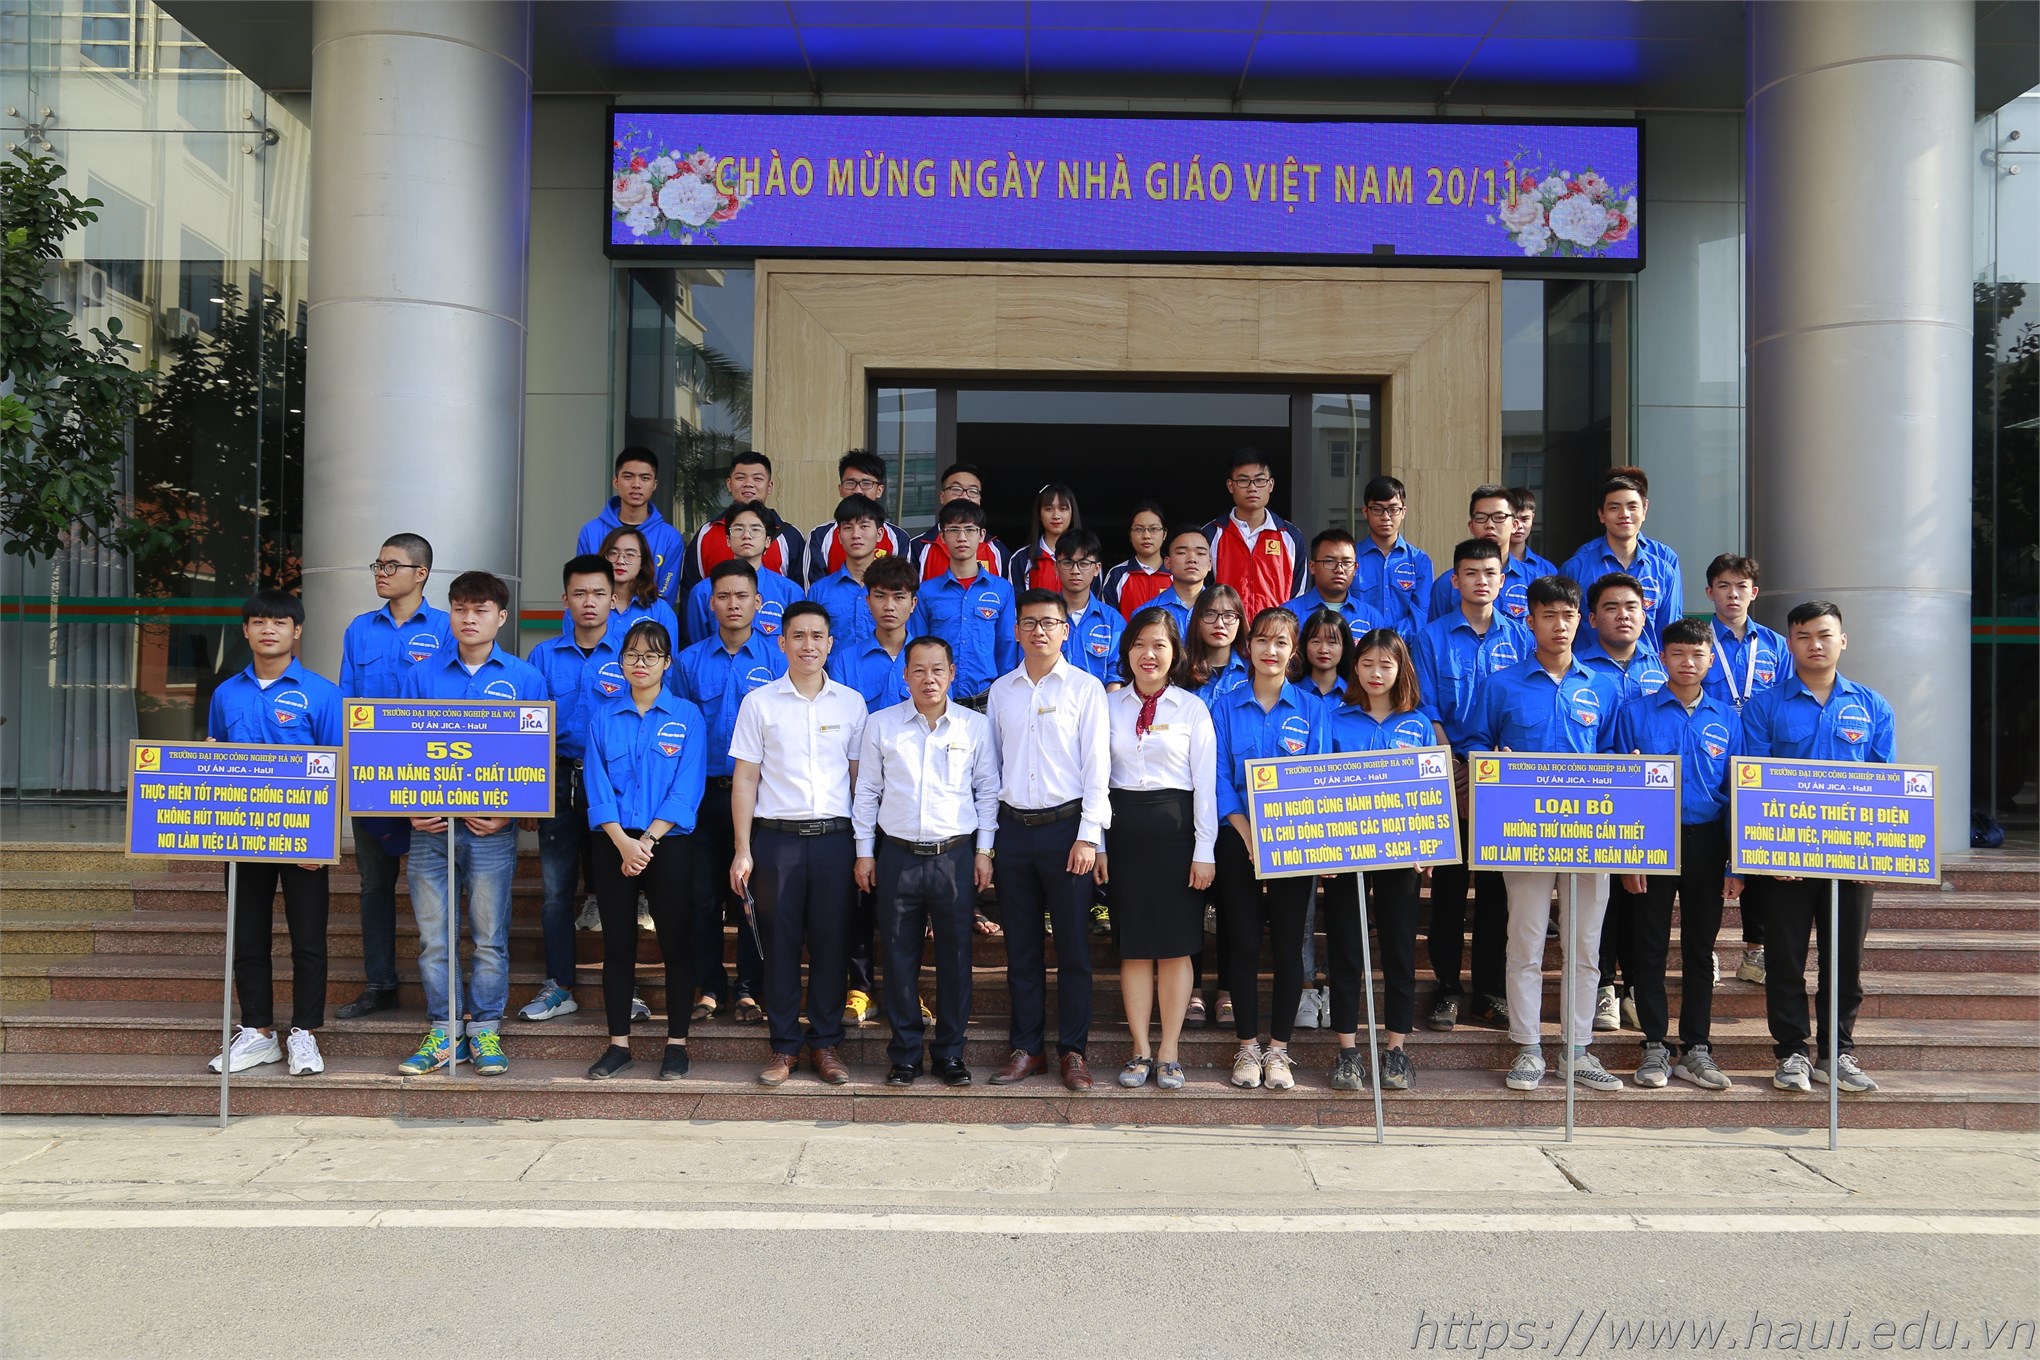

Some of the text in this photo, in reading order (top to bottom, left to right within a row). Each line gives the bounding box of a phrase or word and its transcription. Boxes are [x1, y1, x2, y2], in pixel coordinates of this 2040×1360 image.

[715, 149, 1518, 213] CHÀO MỪNG NGÀY NHÀ GIÁO VIỆT NAM 20/11
[382, 708, 410, 716] TRƯỜNG
[427, 709, 442, 718] HỌC
[443, 709, 462, 717] CÔNG
[464, 710, 490, 719] NGHIỆP
[492, 710, 501, 718] HÀ
[503, 710, 515, 719] NỘI
[412, 722, 424, 730] DỰ
[426, 721, 439, 729] ÁN
[169, 750, 303, 764] TRƯỜNG ĐẠI HỌC CÔNG NGHIỆP HÀ NỘI
[427, 742, 472, 759] 5S
[198, 765, 209, 774] DỰ
[212, 764, 225, 773] ÁN
[352, 762, 545, 785] TẠO RA NĂNG SUẤT CHẤT LƯỢNG
[1285, 757, 1415, 775] TRƯỜNG ĐẠI HỌC CÔNG NGHIỆP NỘI
[1508, 762, 1536, 771] TRƯỜNG
[1552, 764, 1567, 772] HỌC
[1567, 763, 1586, 771] CÔNG
[1589, 764, 1615, 773] NGHIỆP
[1617, 764, 1626, 772] HÀ
[1628, 764, 1641, 773] NỘI
[1770, 767, 1900, 781] TRƯỜNG ĐẠI HỌC CÔNG NGHIỆP NỘI
[1314, 777, 1326, 786] DỰ
[1328, 775, 1340, 783] ÁN
[1368, 773, 1388, 781] HaUI
[1537, 776, 1549, 785] DỰ
[1551, 775, 1564, 783] ÁN
[1798, 782, 1810, 791] DỰ
[1812, 781, 1824, 790] ÁN
[141, 782, 329, 804] THỰC HIỆN TỐT PHÒNG CHỐNG CHÁY NỔ
[390, 785, 508, 808] HIỆU QUẢ CÔNG VIỆC
[1264, 788, 1442, 820] MỌI NGƯỜI CÙNG HÀNH ĐỘNG, TỰ GIÁC
[1535, 794, 1613, 817] LOẠI BỎ
[1762, 798, 1909, 826] TẮT CÁC THIẾT BỊ ĐIỆN
[157, 807, 309, 829] KHÔNG HÚT THUỐC TẠI CƠ QUAN
[1260, 813, 1450, 842] VÀ CHỦ ĐỘNG TRONG CÁC HOẠT ĐỘNG 5S
[1504, 819, 1644, 839] NHỮNG THỨ KHÔNG CẦN THIẾT
[1745, 823, 1926, 852] PHÒNG LÀM VIỆC, PHÒNG HỌC, PHÒNG HỌP
[158, 831, 307, 854] NƠI LÀM VIỆC LÀ THỰC HIỆN 5S
[1271, 839, 1442, 866] VÌ MÔI TRƯỜNG "XANH SẠCH ĐẸP"
[1481, 844, 1667, 865] NƠI LÀM VIỆC SẠCH SẼ, NGĂN NẮP HƠN
[1742, 846, 1929, 875] TRƯỚC KHI RA KHỎI PHÒNG LÀ THỰC HIỆN 5S
